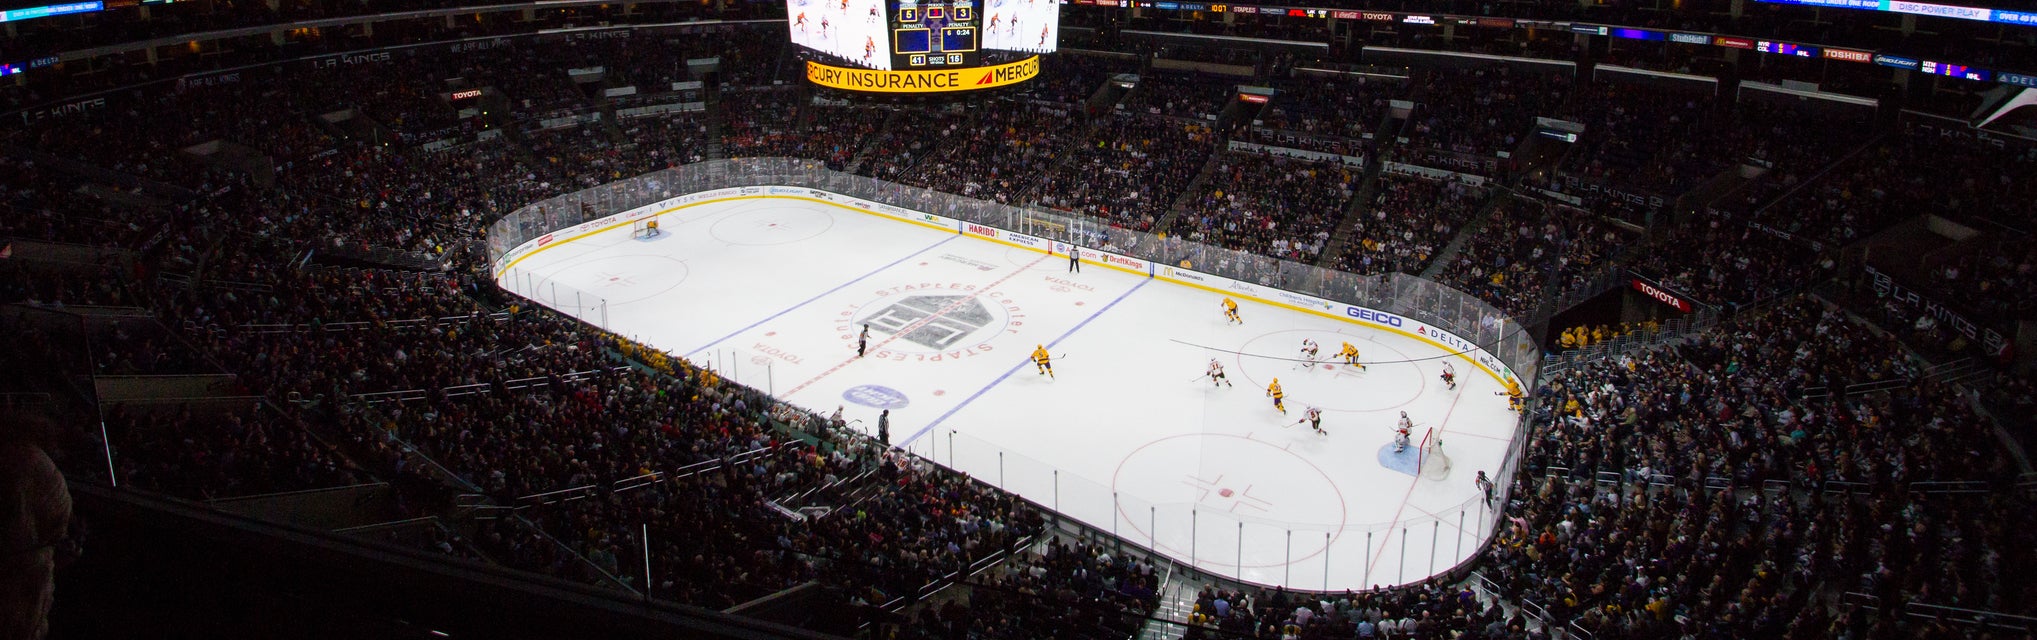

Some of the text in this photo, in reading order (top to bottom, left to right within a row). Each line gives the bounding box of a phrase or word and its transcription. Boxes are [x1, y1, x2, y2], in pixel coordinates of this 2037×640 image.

[905, 10, 913, 19] 5
[960, 9, 967, 17] 3
[1899, 3, 1980, 17] DISC POWER PLAY
[1999, 12, 2019, 21] OVER
[589, 31, 630, 40] KINGS
[1672, 33, 1707, 44] StubHub!
[37, 57, 59, 66] DELTA
[343, 51, 391, 65] KINGS
[1824, 48, 1871, 62] TOSHIBA
[1878, 56, 1918, 67] BUD LIGHT
[807, 65, 959, 88] ERCURY INSURANCE
[995, 62, 1039, 82] MERCUR
[2011, 75, 2037, 86] DEL
[453, 90, 482, 100] TOYOTA
[1580, 182, 1645, 206] LA KINGS
[590, 217, 617, 228] TOYOTA
[968, 224, 995, 237] HARIBO
[1009, 233, 1039, 242] AMERICAN
[1009, 237, 1034, 246] EXPRESS
[1110, 255, 1143, 269] DraftKings
[1045, 275, 1095, 292] TOYOTA
[1175, 271, 1204, 282] McDonald's
[875, 283, 977, 297] STAPLES
[1640, 282, 1681, 309] TOYOTA
[990, 291, 1026, 335] Center
[1347, 306, 1402, 327] GEICO
[1893, 285, 1977, 340] LA KINGS
[1430, 329, 1470, 352] DELTA
[752, 342, 804, 365] TOYOTA
[876, 343, 993, 362] STAPLES
